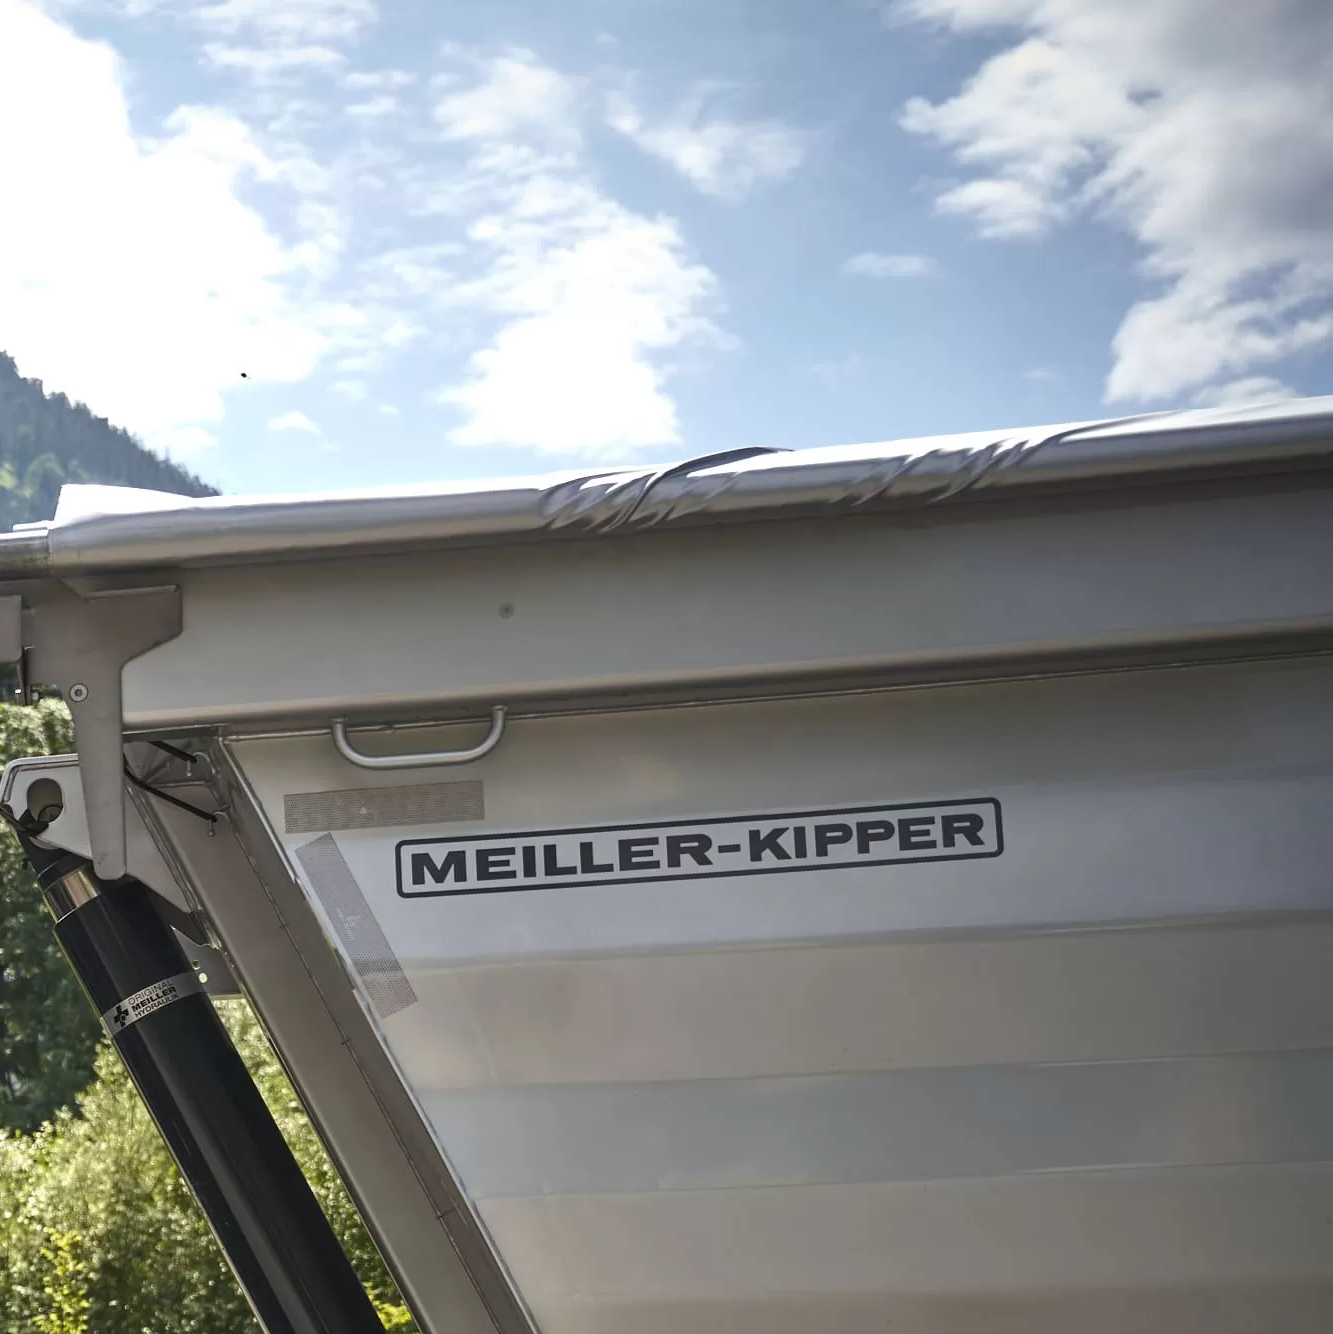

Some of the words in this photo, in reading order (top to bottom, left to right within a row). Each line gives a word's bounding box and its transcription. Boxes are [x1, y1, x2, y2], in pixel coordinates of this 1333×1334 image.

[409, 811, 987, 886] MEILLER-KIPPER
[128, 979, 174, 1006] ORIGINAL
[131, 985, 177, 1013] MEILLER
